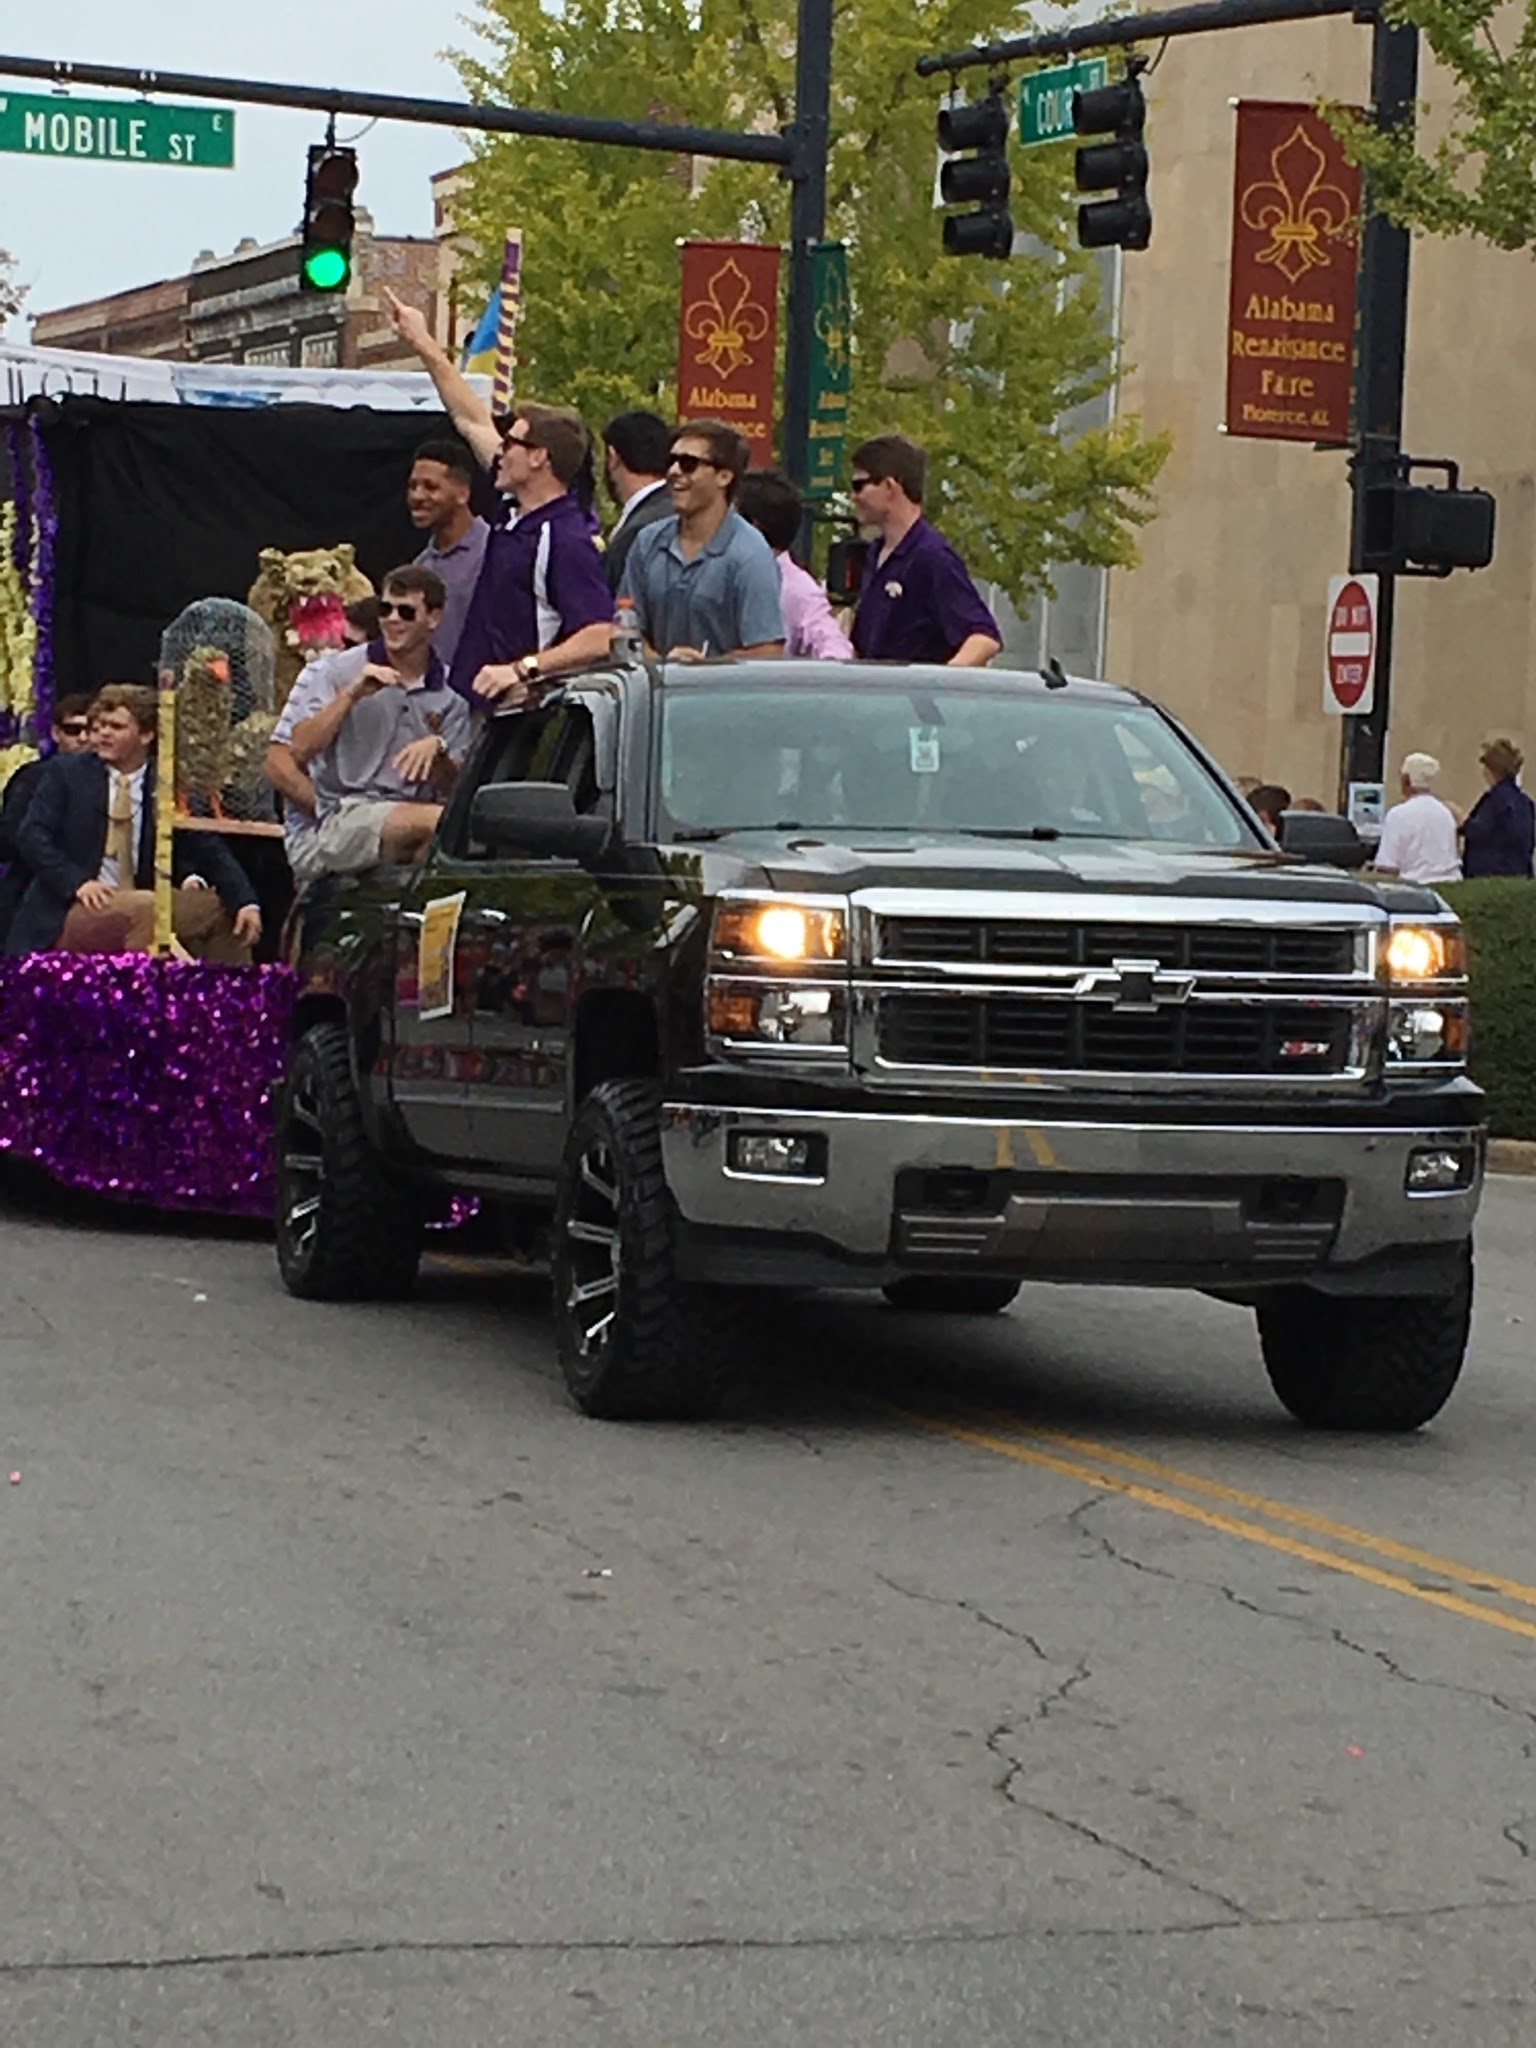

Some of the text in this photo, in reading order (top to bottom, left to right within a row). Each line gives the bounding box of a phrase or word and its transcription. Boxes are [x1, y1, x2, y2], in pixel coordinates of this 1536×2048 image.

[25, 111, 223, 162] MOBILE ST E
[1245, 292, 1335, 324] Alabama
